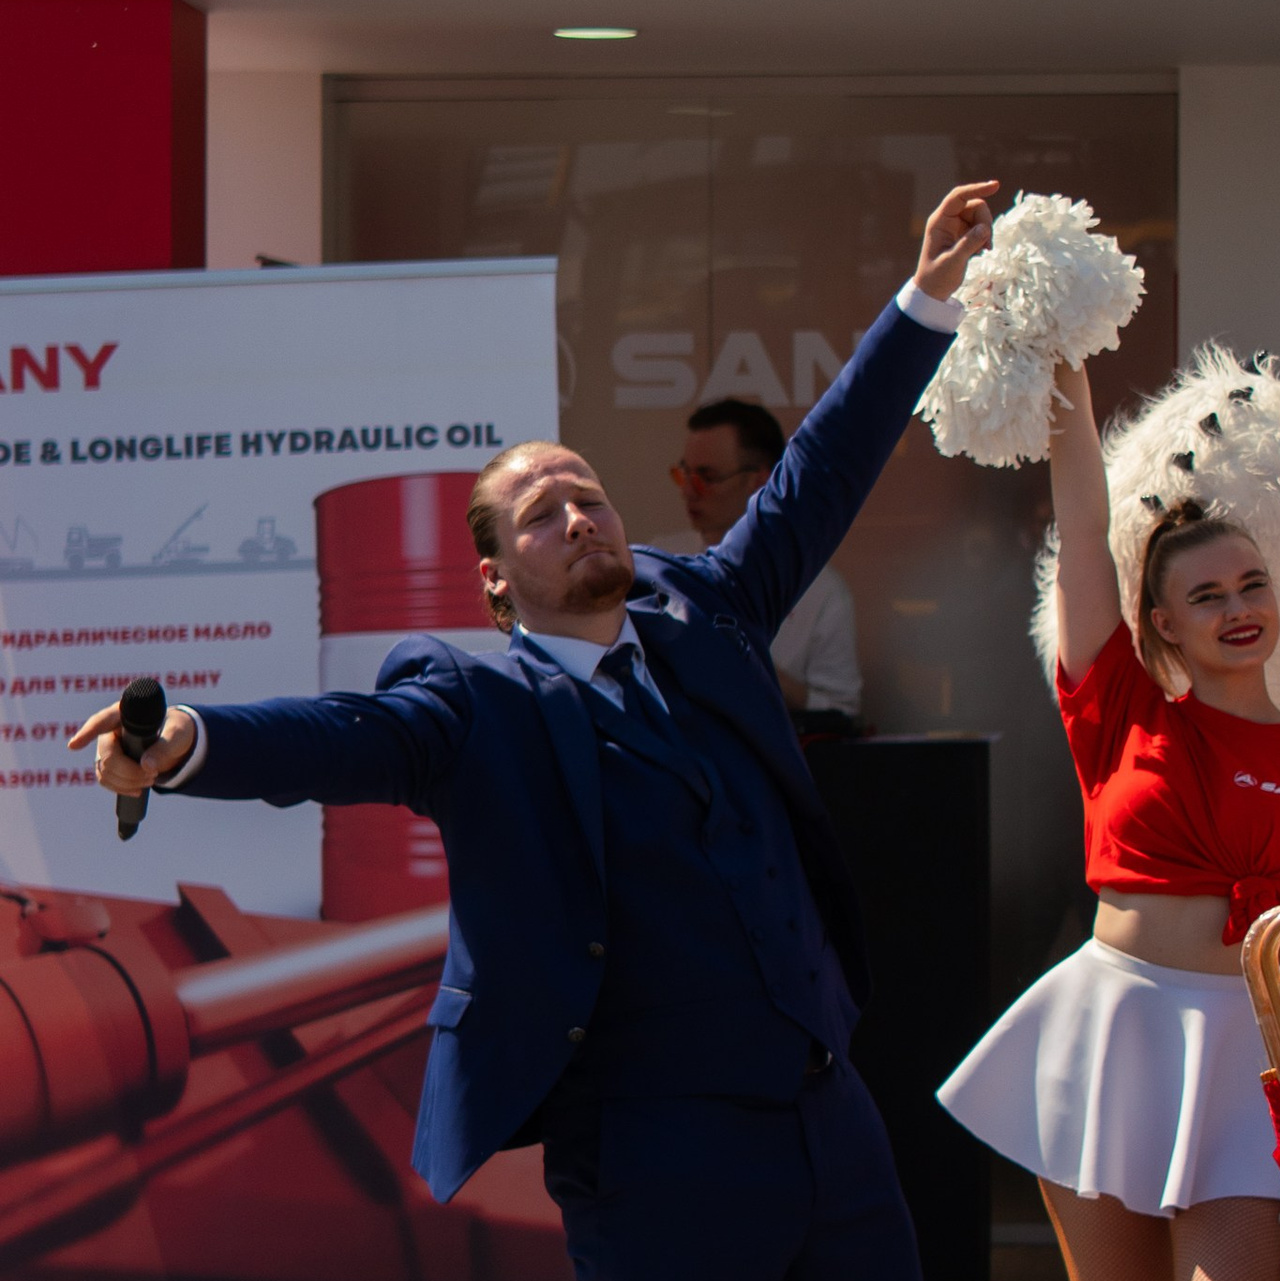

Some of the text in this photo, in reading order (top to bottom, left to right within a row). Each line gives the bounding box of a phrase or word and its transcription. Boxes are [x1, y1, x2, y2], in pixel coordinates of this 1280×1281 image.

[0, 341, 118, 394] NY
[40, 437, 61, 465] &
[70, 432, 232, 464] LONGLIFE
[241, 425, 438, 456] HYDRAULIC
[446, 423, 502, 449] OIL
[0, 621, 271, 652] ИДРАВЛИЧЕСКОЕ МАСЛО
[10, 676, 55, 697] ДЛЯ
[166, 671, 221, 690] SANY
[32, 723, 58, 740] ОТ
